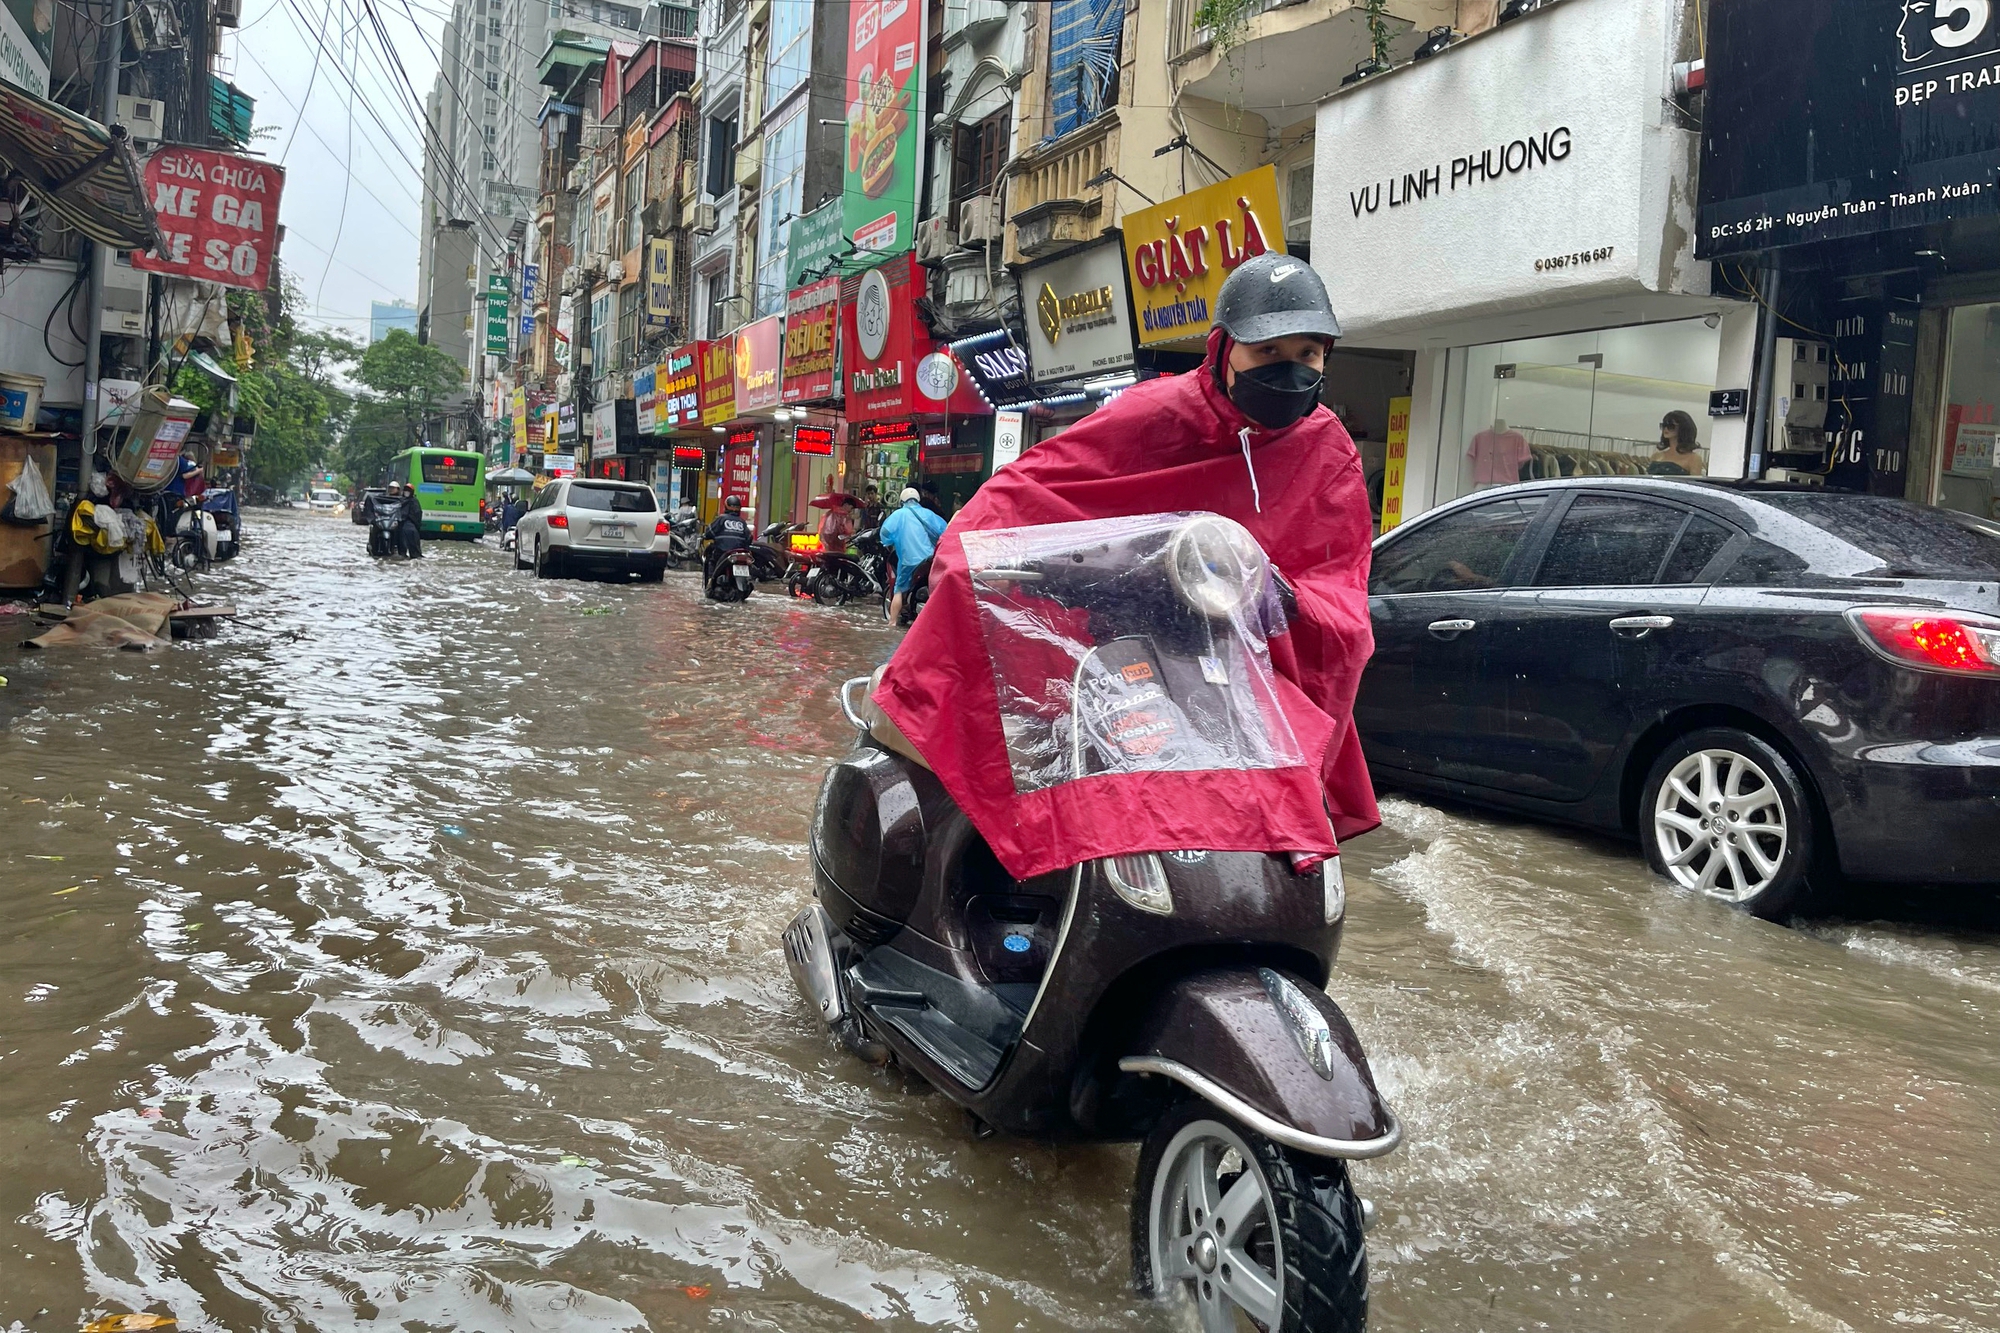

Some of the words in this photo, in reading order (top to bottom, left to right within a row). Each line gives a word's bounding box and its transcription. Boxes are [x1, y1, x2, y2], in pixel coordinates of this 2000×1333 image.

[1894, 80, 1938, 106] ĐẸP
[1945, 65, 2000, 94] TRAI
[160, 154, 206, 182] SỬA
[210, 166, 266, 194] CHỮA
[1350, 182, 1380, 217] VU
[1389, 164, 1440, 207] LINH
[1451, 127, 1572, 190] PHUONG
[154, 182, 201, 219] XE
[212, 194, 264, 232] GA
[1711, 224, 1733, 238] ĐC:
[1736, 218, 1752, 234] Số
[1755, 217, 1773, 231] 2H
[1786, 205, 1838, 227] Nguyễn
[1842, 199, 1876, 217] Tuân
[1890, 189, 1936, 208] Thanh
[1941, 182, 1981, 199] Xuân
[204, 238, 261, 277] SỐ
[1135, 215, 1209, 293] GIẶT
[1215, 196, 1270, 268] LÀ
[1274, 264, 1297, 275] NIKE
[1836, 315, 1864, 338] HAIR
[1722, 392, 1730, 404] 2
[1390, 412, 1408, 435] GIẶT
[1876, 448, 1900, 475] TẠO
[1125, 665, 1151, 679] hub
